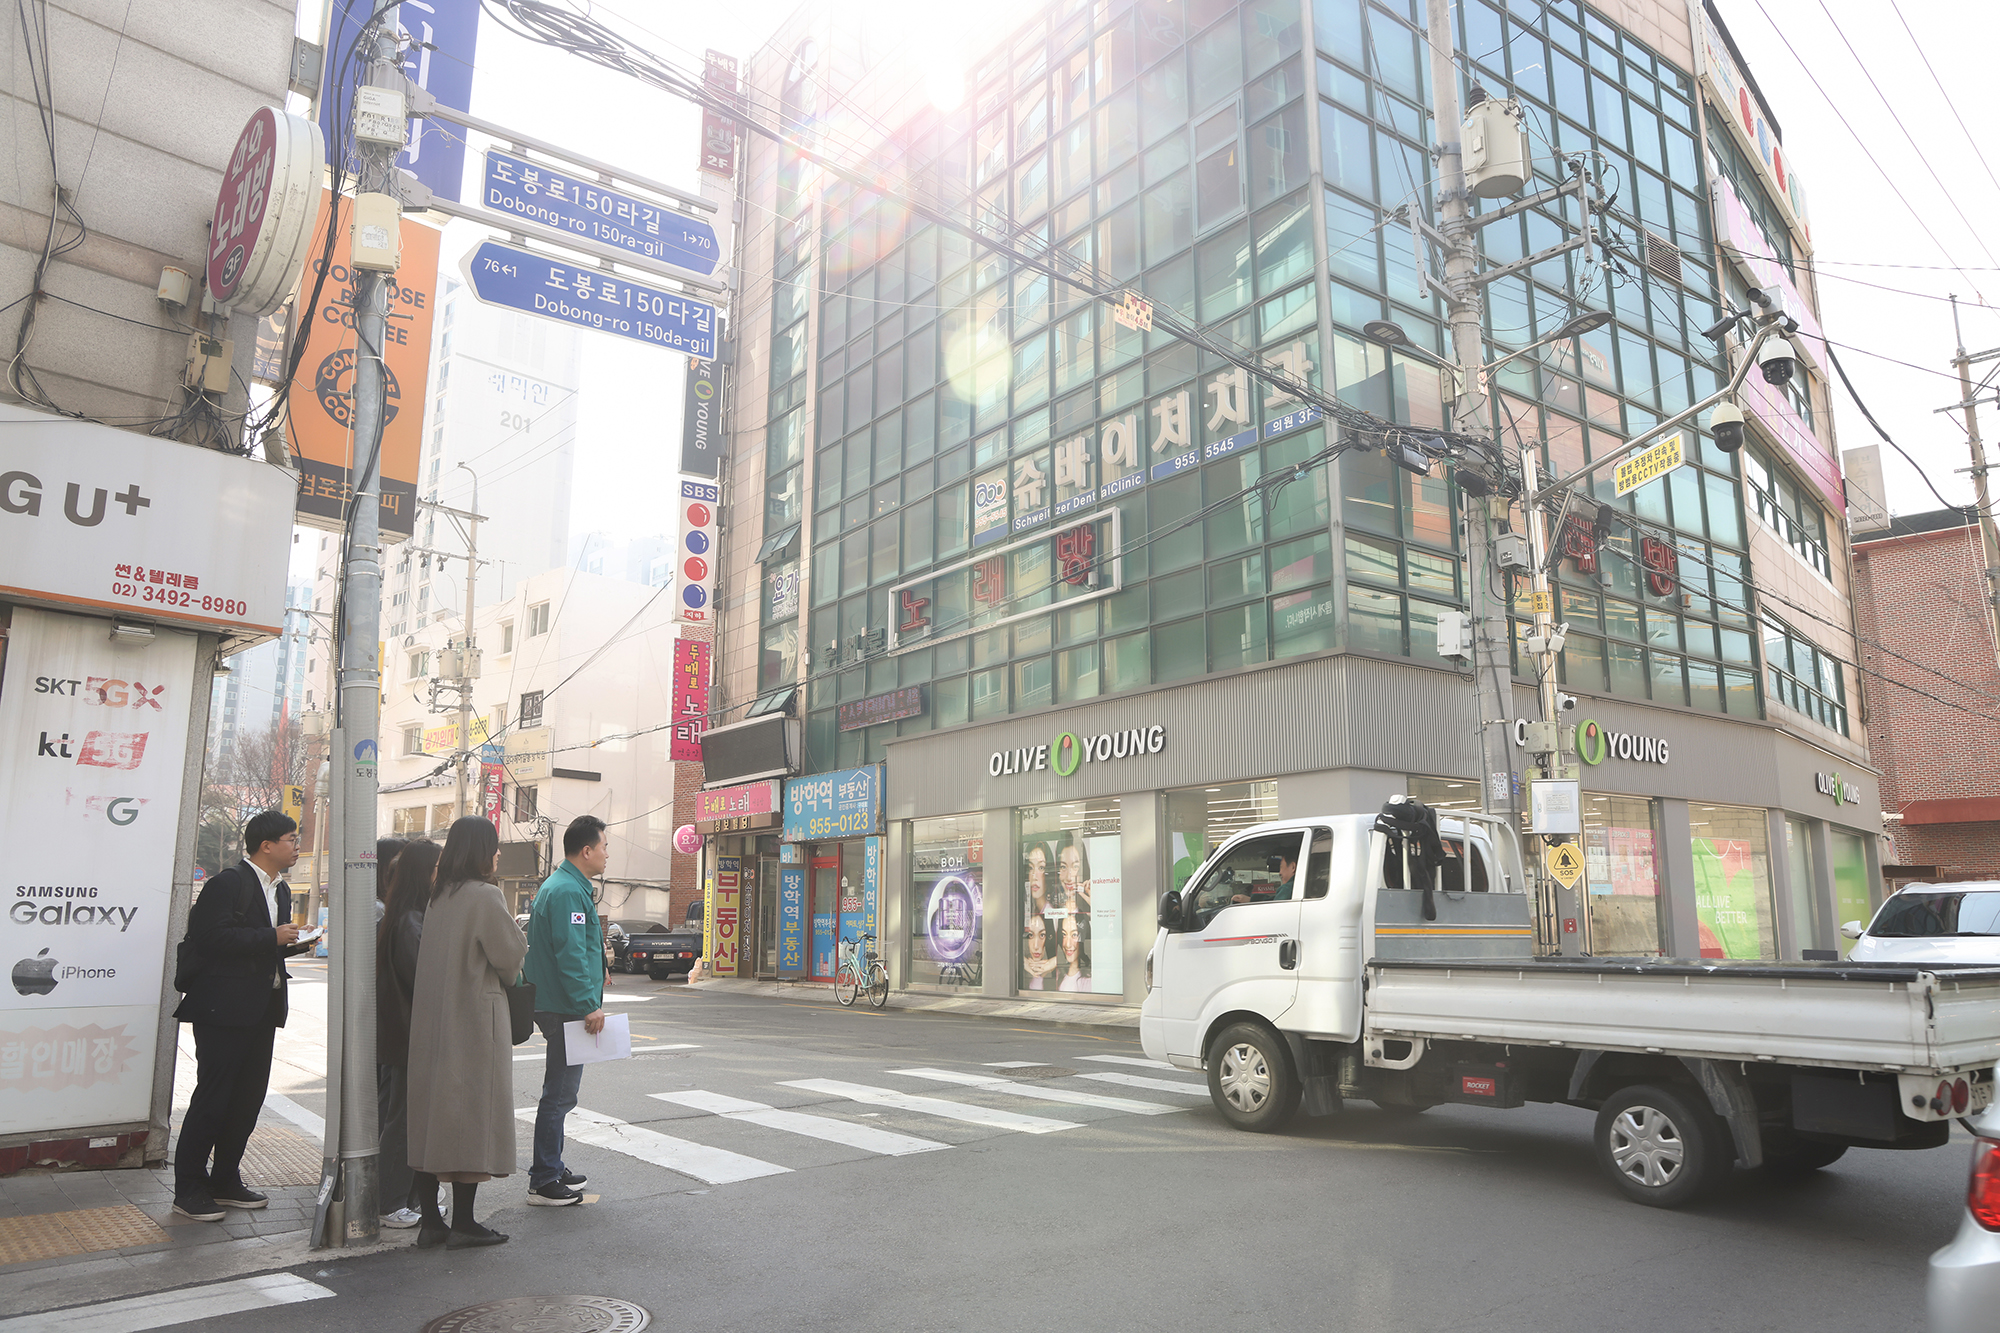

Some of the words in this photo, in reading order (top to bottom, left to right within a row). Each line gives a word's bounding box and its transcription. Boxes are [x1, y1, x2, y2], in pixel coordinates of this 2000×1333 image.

[707, 154, 729, 168] 2F
[202, 147, 272, 262] 노래방
[492, 159, 660, 235] 도봉로150라길
[490, 188, 587, 232] Dobong-ro
[593, 222, 664, 256] 150ra-gil
[697, 234, 711, 249] 70
[225, 252, 241, 280] 3F
[483, 258, 499, 272] 76
[313, 258, 426, 309] COOSE
[545, 267, 709, 333] 도봉로150다길
[322, 306, 408, 346] COEE
[535, 293, 630, 332] Dobong-ro
[636, 321, 709, 354] 150da-gil
[500, 411, 531, 433] 201
[695, 402, 709, 450] YOUNG
[1272, 415, 1294, 433] 의원
[1298, 410, 1315, 424] 3F
[64, 482, 151, 527] U+
[683, 484, 716, 499] SBS
[773, 569, 799, 603] 요가
[901, 523, 1096, 632] 노래방
[112, 582, 137, 597] 02)
[142, 586, 247, 616] 3492-8980
[684, 644, 699, 689] 두배로
[35, 677, 81, 696] SKT
[677, 695, 702, 744] 노래
[425, 728, 455, 750] 상가임대
[990, 745, 1047, 776] OLIVE
[1083, 725, 1164, 763] YOUNG
[1607, 731, 1669, 765] YOUNG
[704, 796, 726, 815] 두배로
[729, 791, 750, 812] 노래
[791, 779, 833, 815] 방학역
[838, 780, 867, 799] 부동산
[1818, 772, 1836, 797] OLIVE
[1842, 779, 1860, 805] YOUNG
[681, 835, 699, 845] 요가
[809, 812, 868, 835] 955-0123
[719, 860, 739, 870] 방학역
[866, 845, 878, 910] 방학역
[941, 857, 964, 868] BOH
[16, 885, 98, 898] SAMSUNG
[783, 875, 801, 919] 방학역
[1696, 895, 1711, 908] ALL
[1713, 895, 1730, 909] LIVE
[10, 901, 138, 932] Galaxy
[714, 872, 739, 973] 부동산
[1715, 911, 1748, 924] BETTER
[783, 921, 801, 966] 부동산
[61, 966, 116, 979] iPhone
[0, 1037, 118, 1080] 할인매장
[1467, 1081, 1490, 1090] ROCKET
